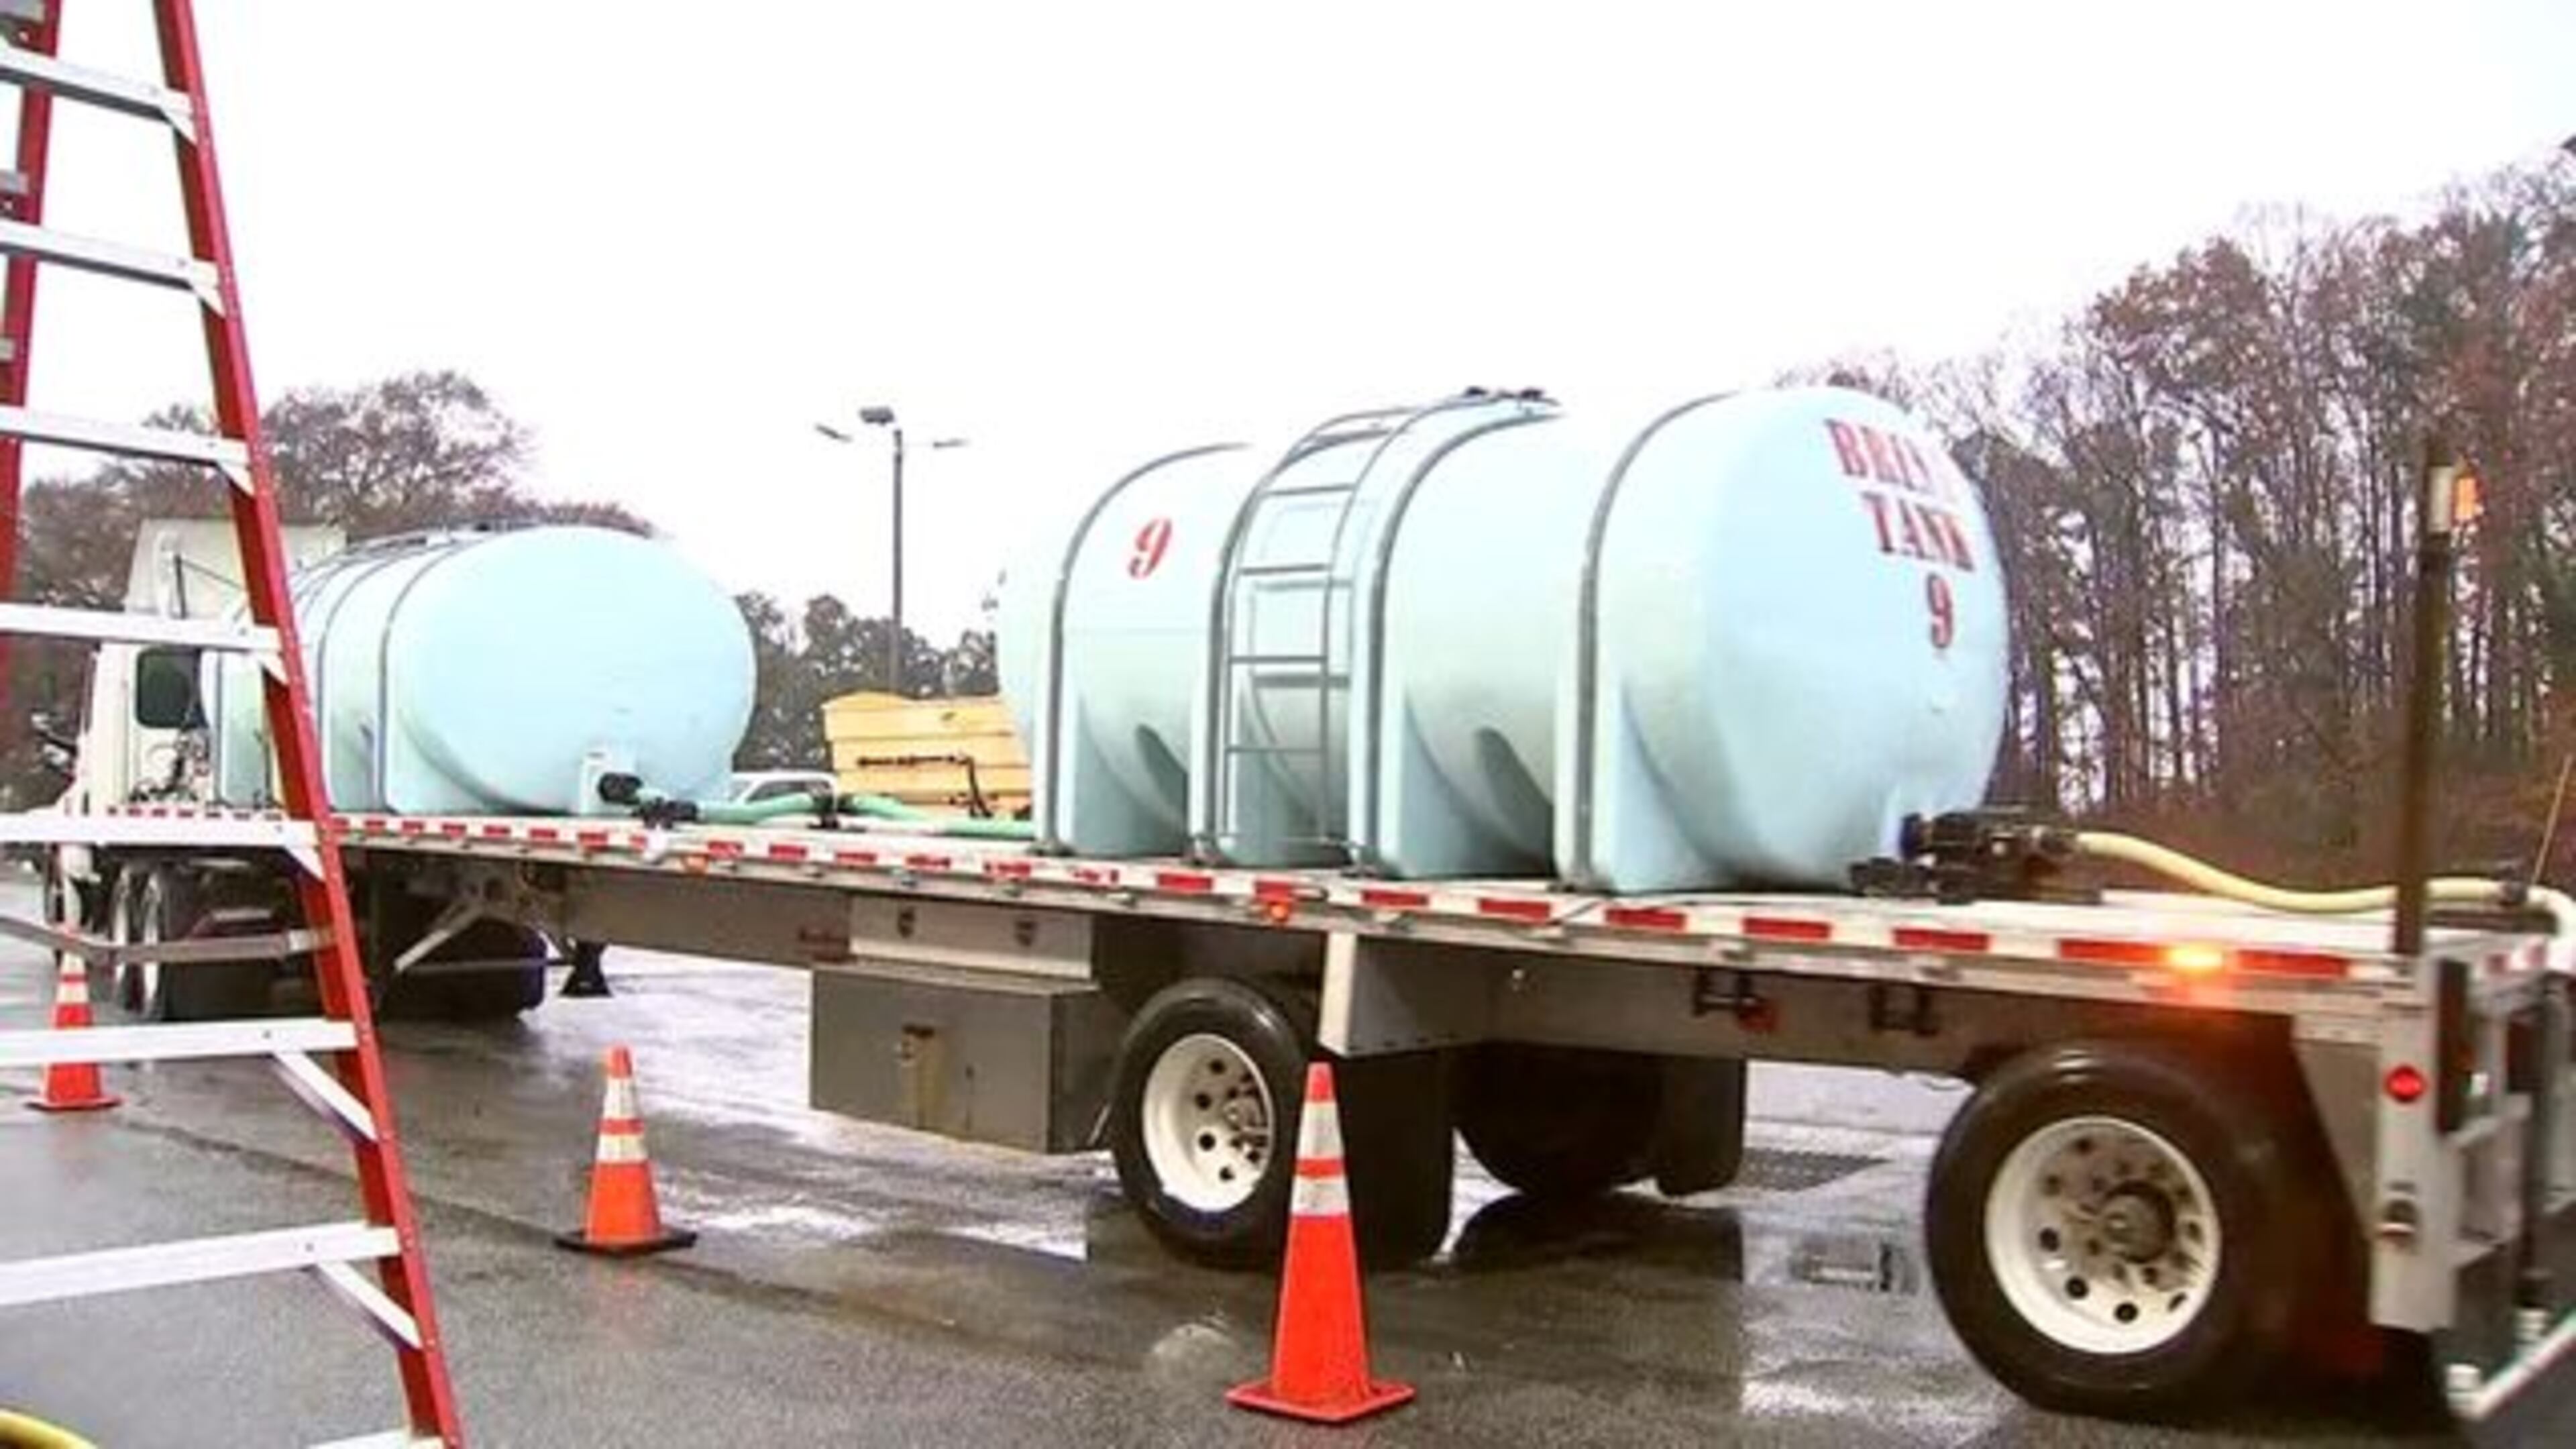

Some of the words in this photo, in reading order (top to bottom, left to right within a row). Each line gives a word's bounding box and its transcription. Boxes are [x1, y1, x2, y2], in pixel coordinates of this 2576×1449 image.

[1824, 417, 1945, 495] BRI
[1128, 517, 1172, 579] 9
[1927, 572, 1953, 649] 9
